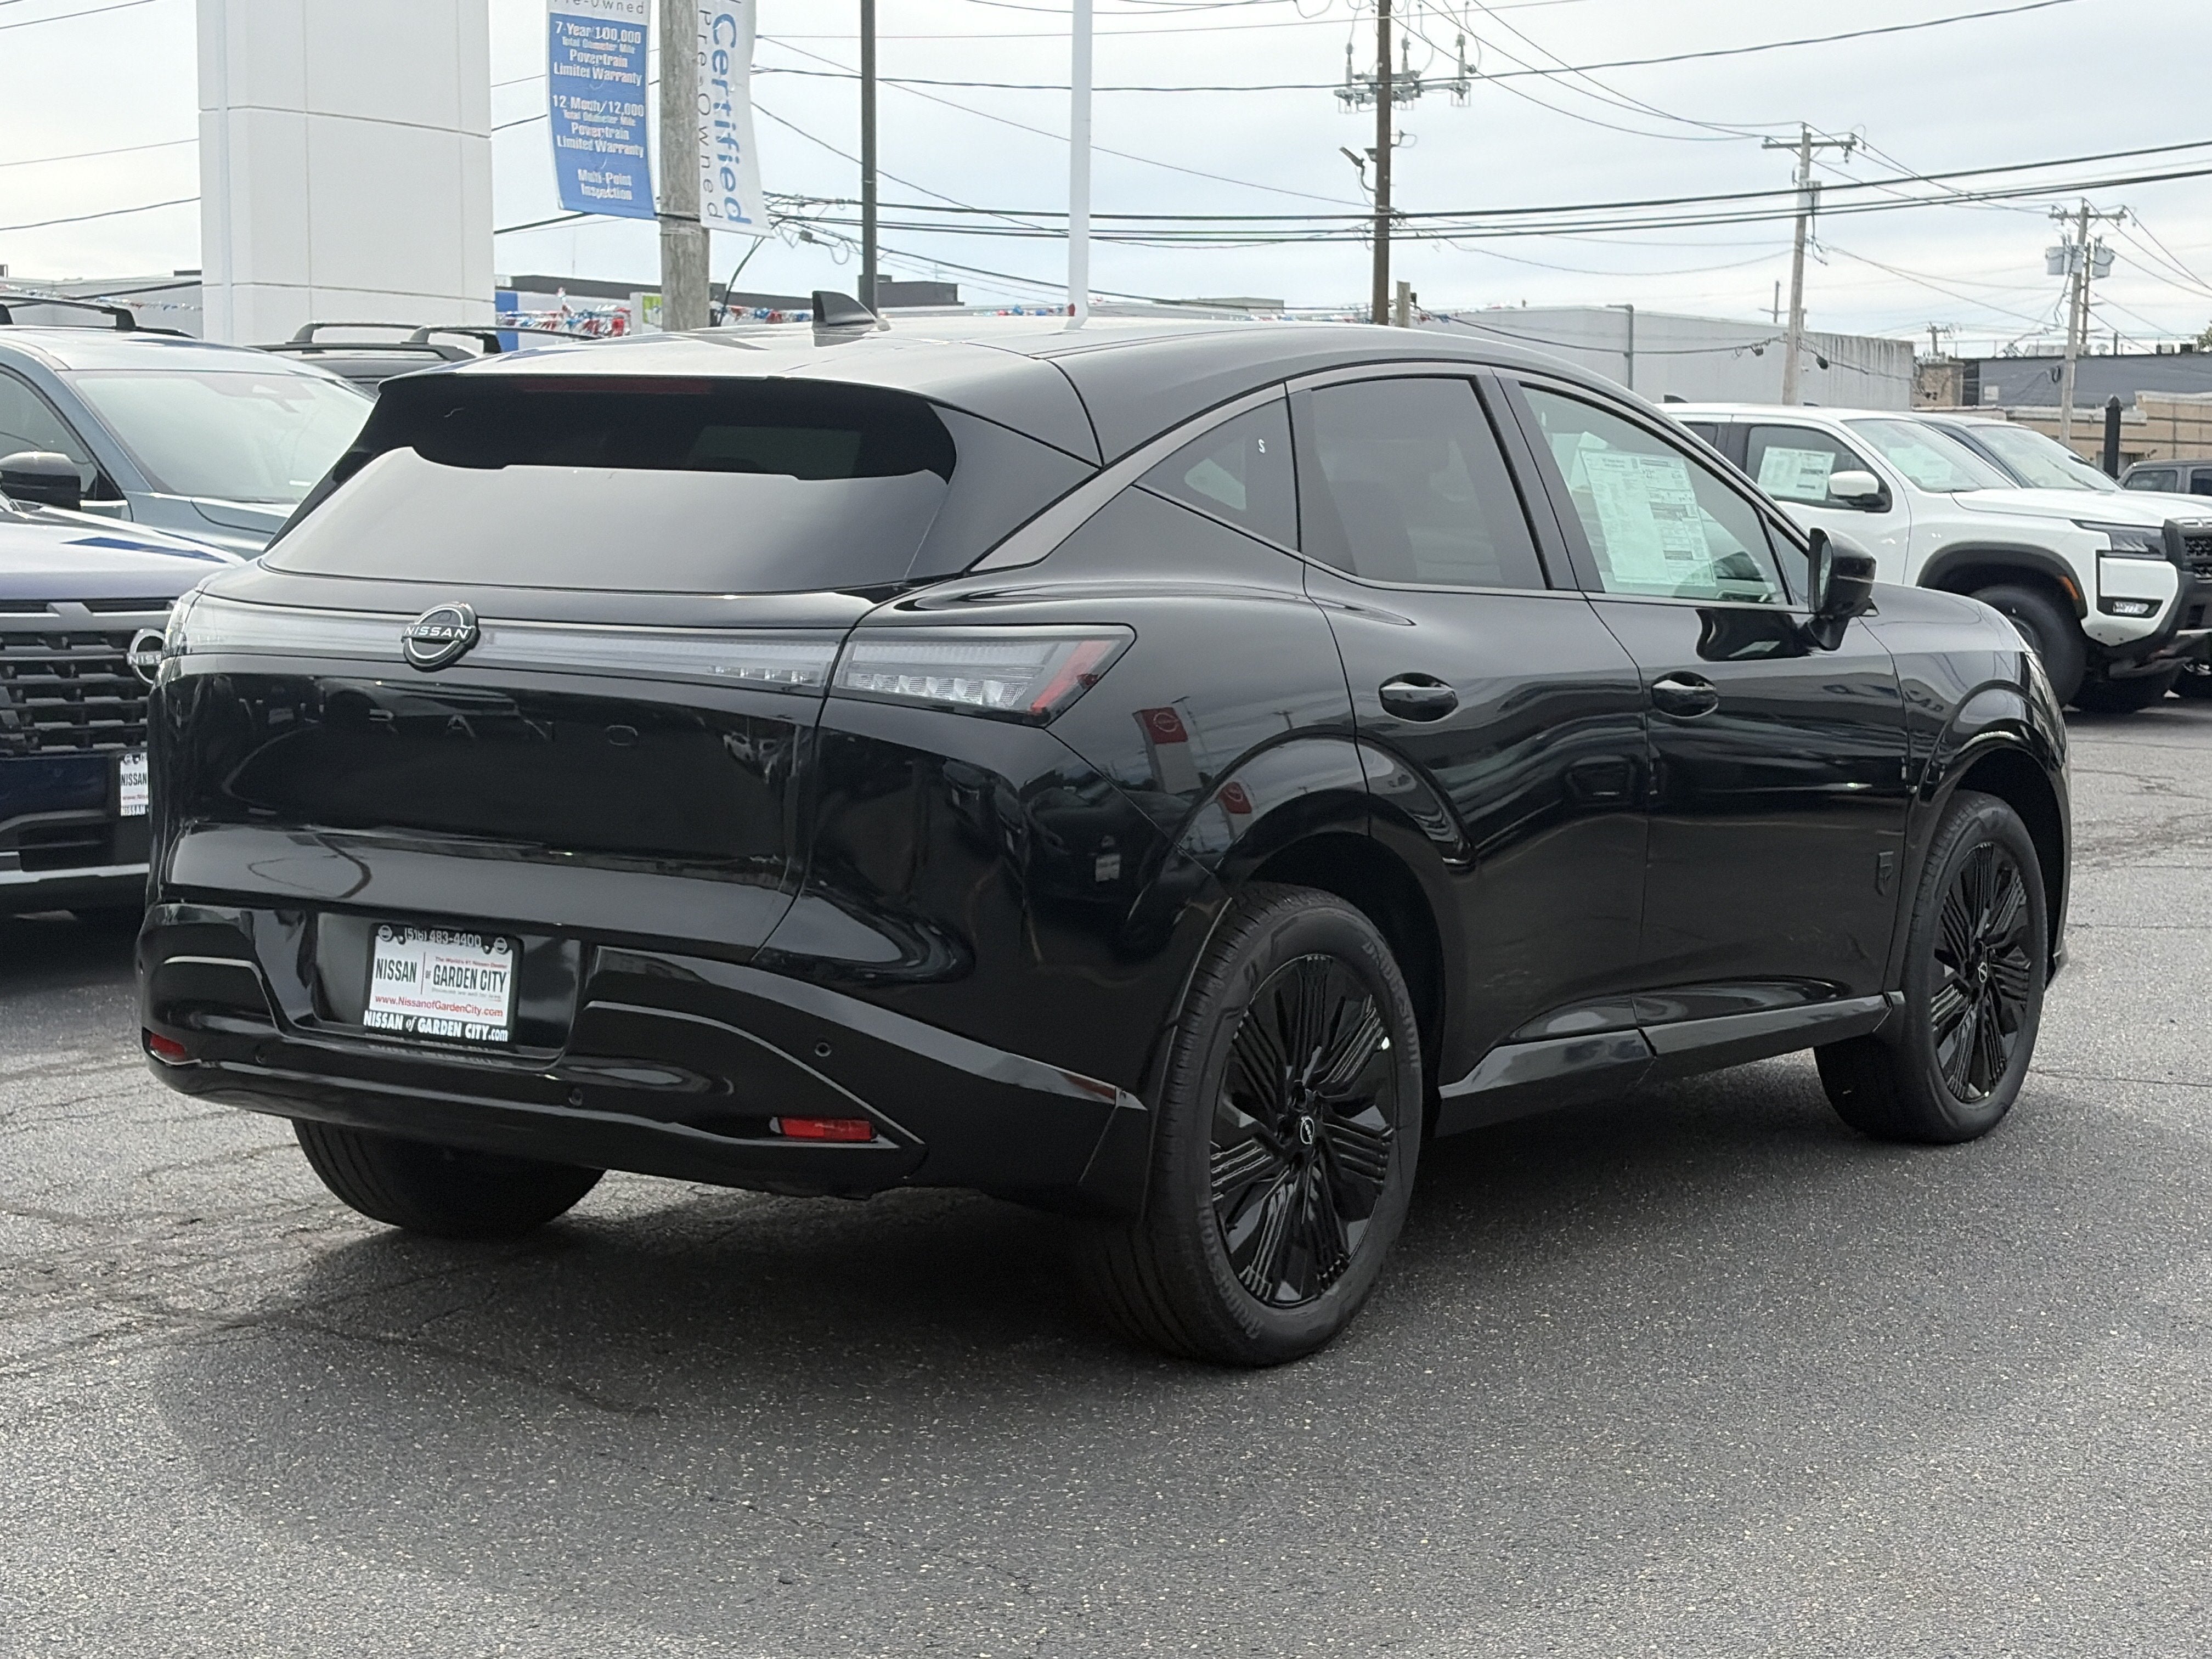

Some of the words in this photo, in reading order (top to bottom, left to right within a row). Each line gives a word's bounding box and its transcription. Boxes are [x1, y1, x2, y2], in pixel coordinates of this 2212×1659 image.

[554, 0, 644, 14] e-Owned
[569, 48, 628, 68] Powertrain
[592, 66, 642, 87] Warranty
[711, 13, 752, 224] Certified
[571, 122, 630, 140] Powertrain
[595, 139, 644, 158] Warranty
[1257, 439, 1266, 454] S
[404, 626, 469, 639] NISSAN
[128, 654, 161, 665] NISS
[121, 772, 147, 786] NISSAN
[428, 929, 482, 947] 483-4400
[375, 958, 417, 983] NISSAN
[433, 964, 478, 990] GARDEN
[480, 969, 507, 993] CITY
[375, 995, 504, 1017] www.NissanofGardenCity.com
[363, 1009, 403, 1031] NISSAN
[406, 1017, 416, 1032] of
[417, 1018, 462, 1037] GARDEN
[465, 1023, 509, 1042] CITY.com
